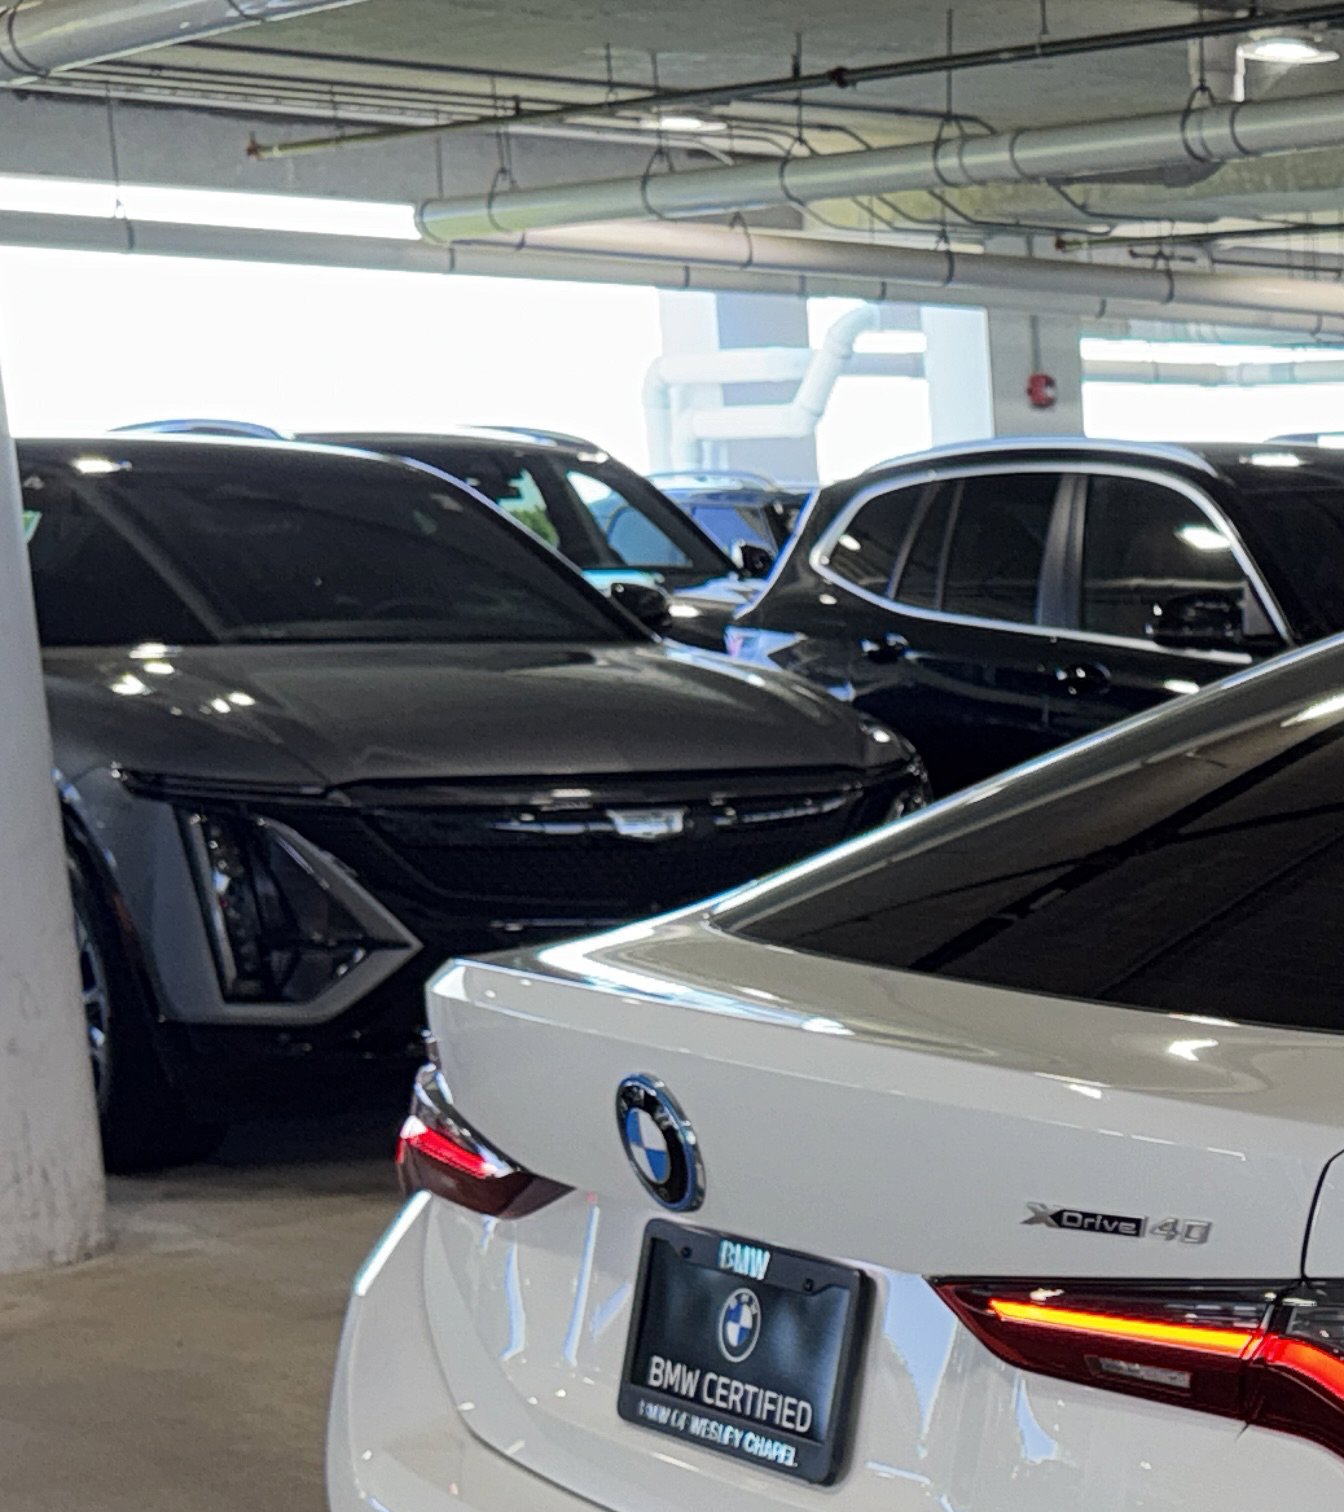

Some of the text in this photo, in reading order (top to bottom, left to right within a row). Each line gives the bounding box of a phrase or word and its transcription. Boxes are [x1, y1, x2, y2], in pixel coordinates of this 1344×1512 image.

[719, 1239, 771, 1281] BMW
[648, 1355, 813, 1433] BMW CERTIFIED
